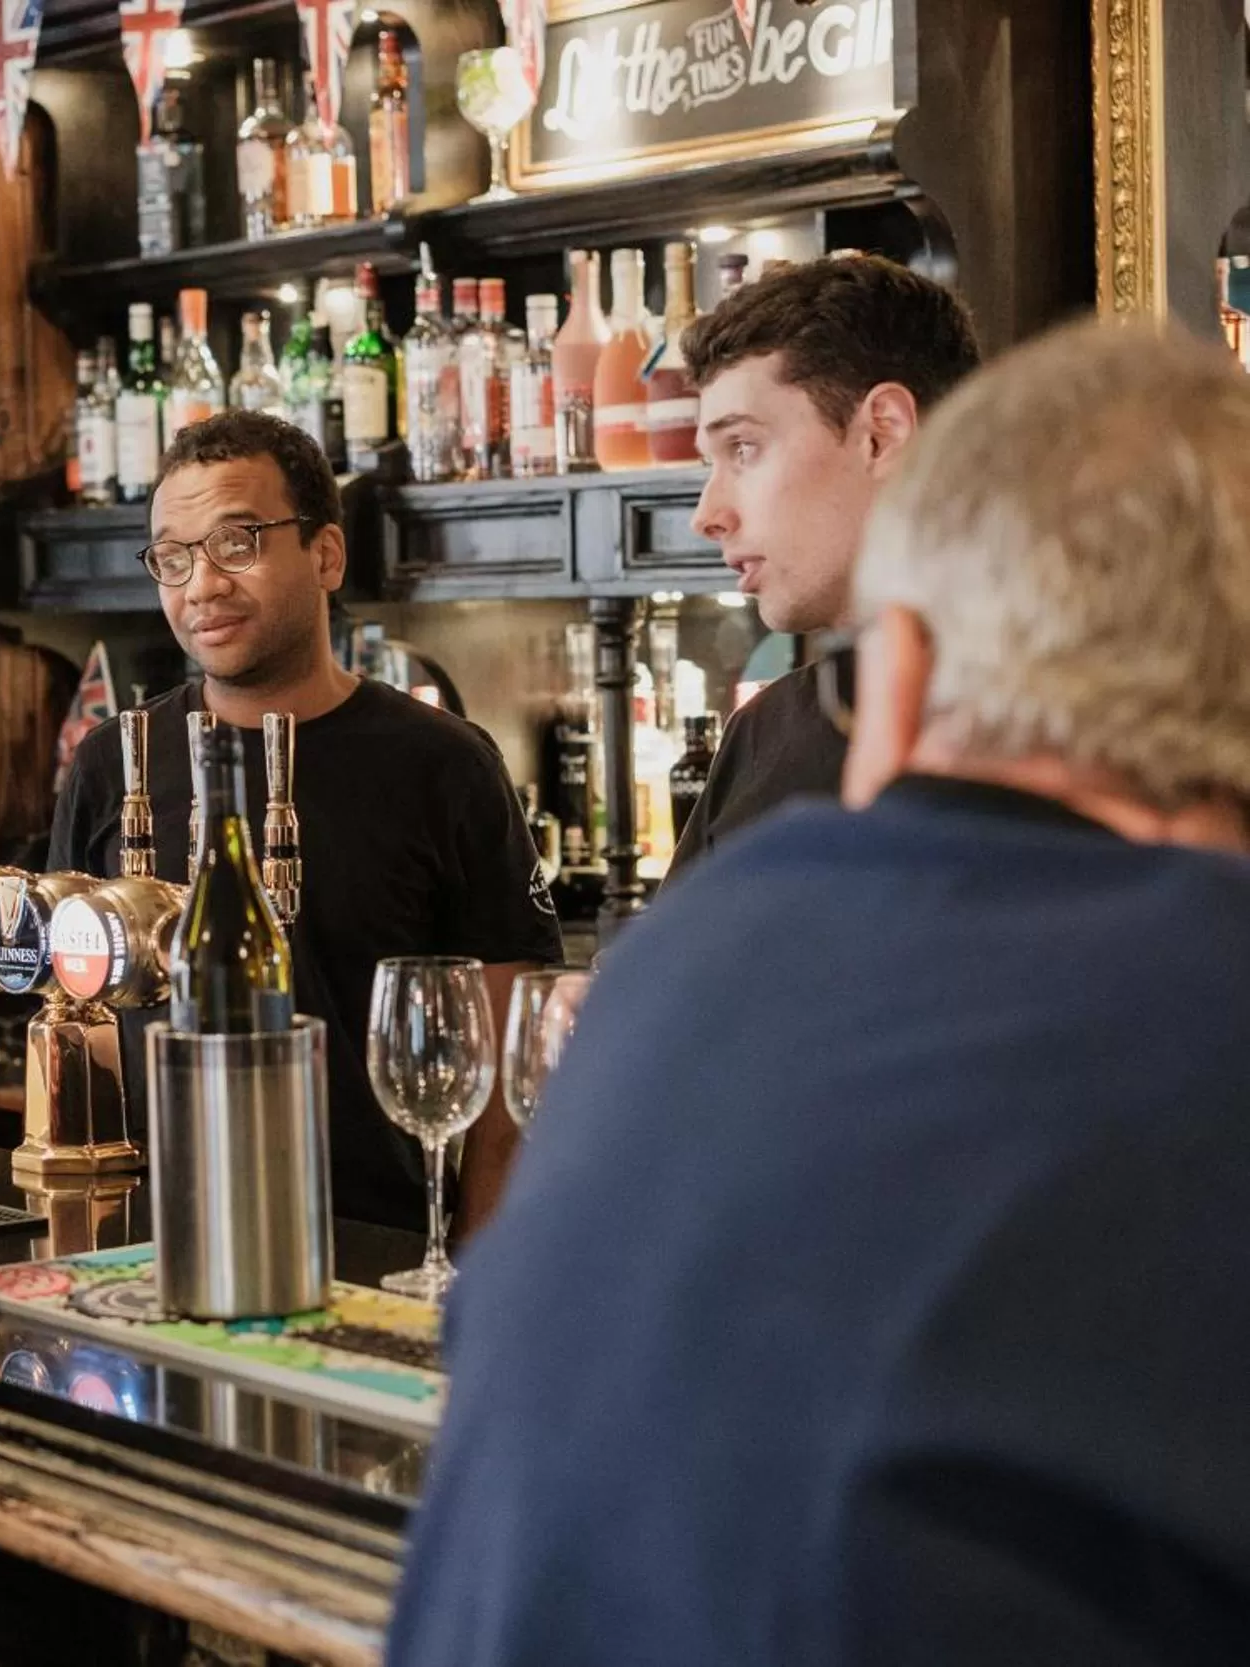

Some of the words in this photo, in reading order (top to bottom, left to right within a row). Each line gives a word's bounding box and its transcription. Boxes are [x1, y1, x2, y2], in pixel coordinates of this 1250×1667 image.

[624, 20, 687, 115] the
[688, 46, 746, 96] TIMES
[694, 17, 735, 58] FUN
[749, 0, 807, 84] be
